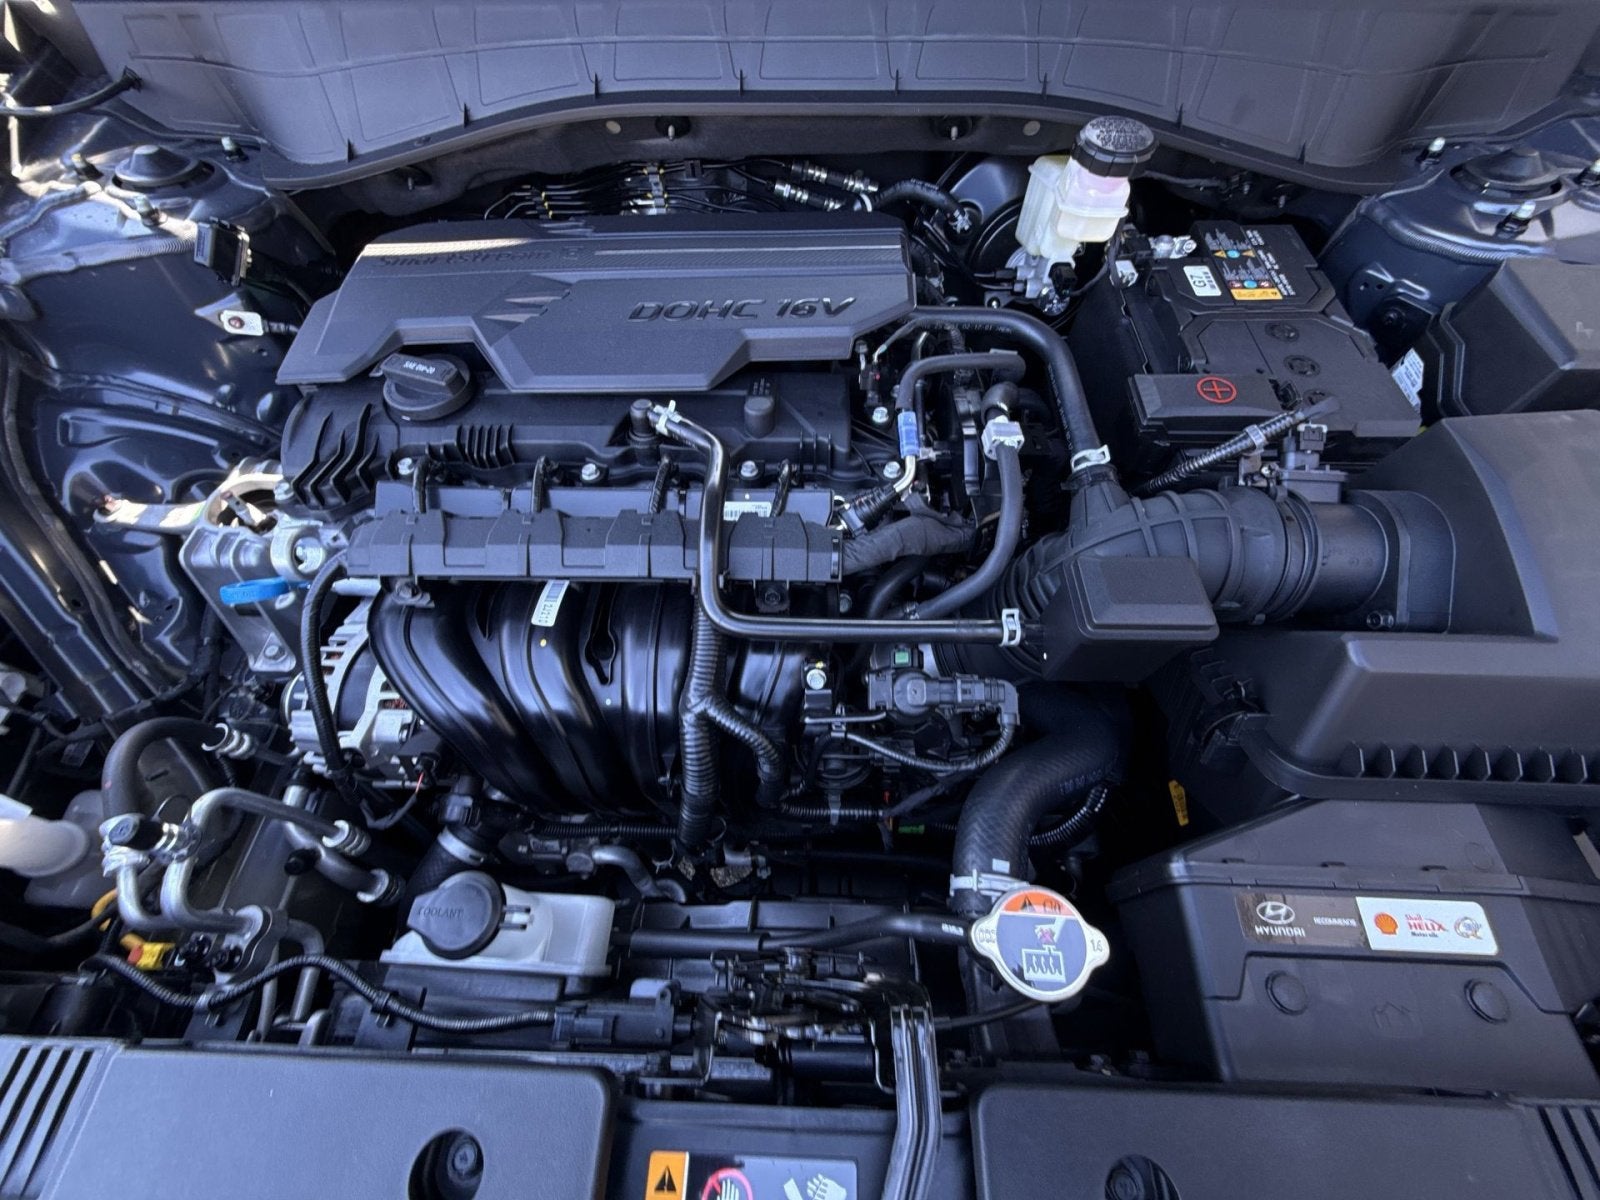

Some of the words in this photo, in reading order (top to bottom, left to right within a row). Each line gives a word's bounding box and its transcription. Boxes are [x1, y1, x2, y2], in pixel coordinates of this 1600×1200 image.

[1190, 274, 1207, 288] G7
[627, 298, 766, 322] DOHC
[775, 297, 857, 319] 16V
[418, 906, 464, 920] COOLANT
[1405, 913, 1423, 921] Shell
[1254, 924, 1306, 938] HYUNDAI
[1407, 919, 1448, 932] HELIX
